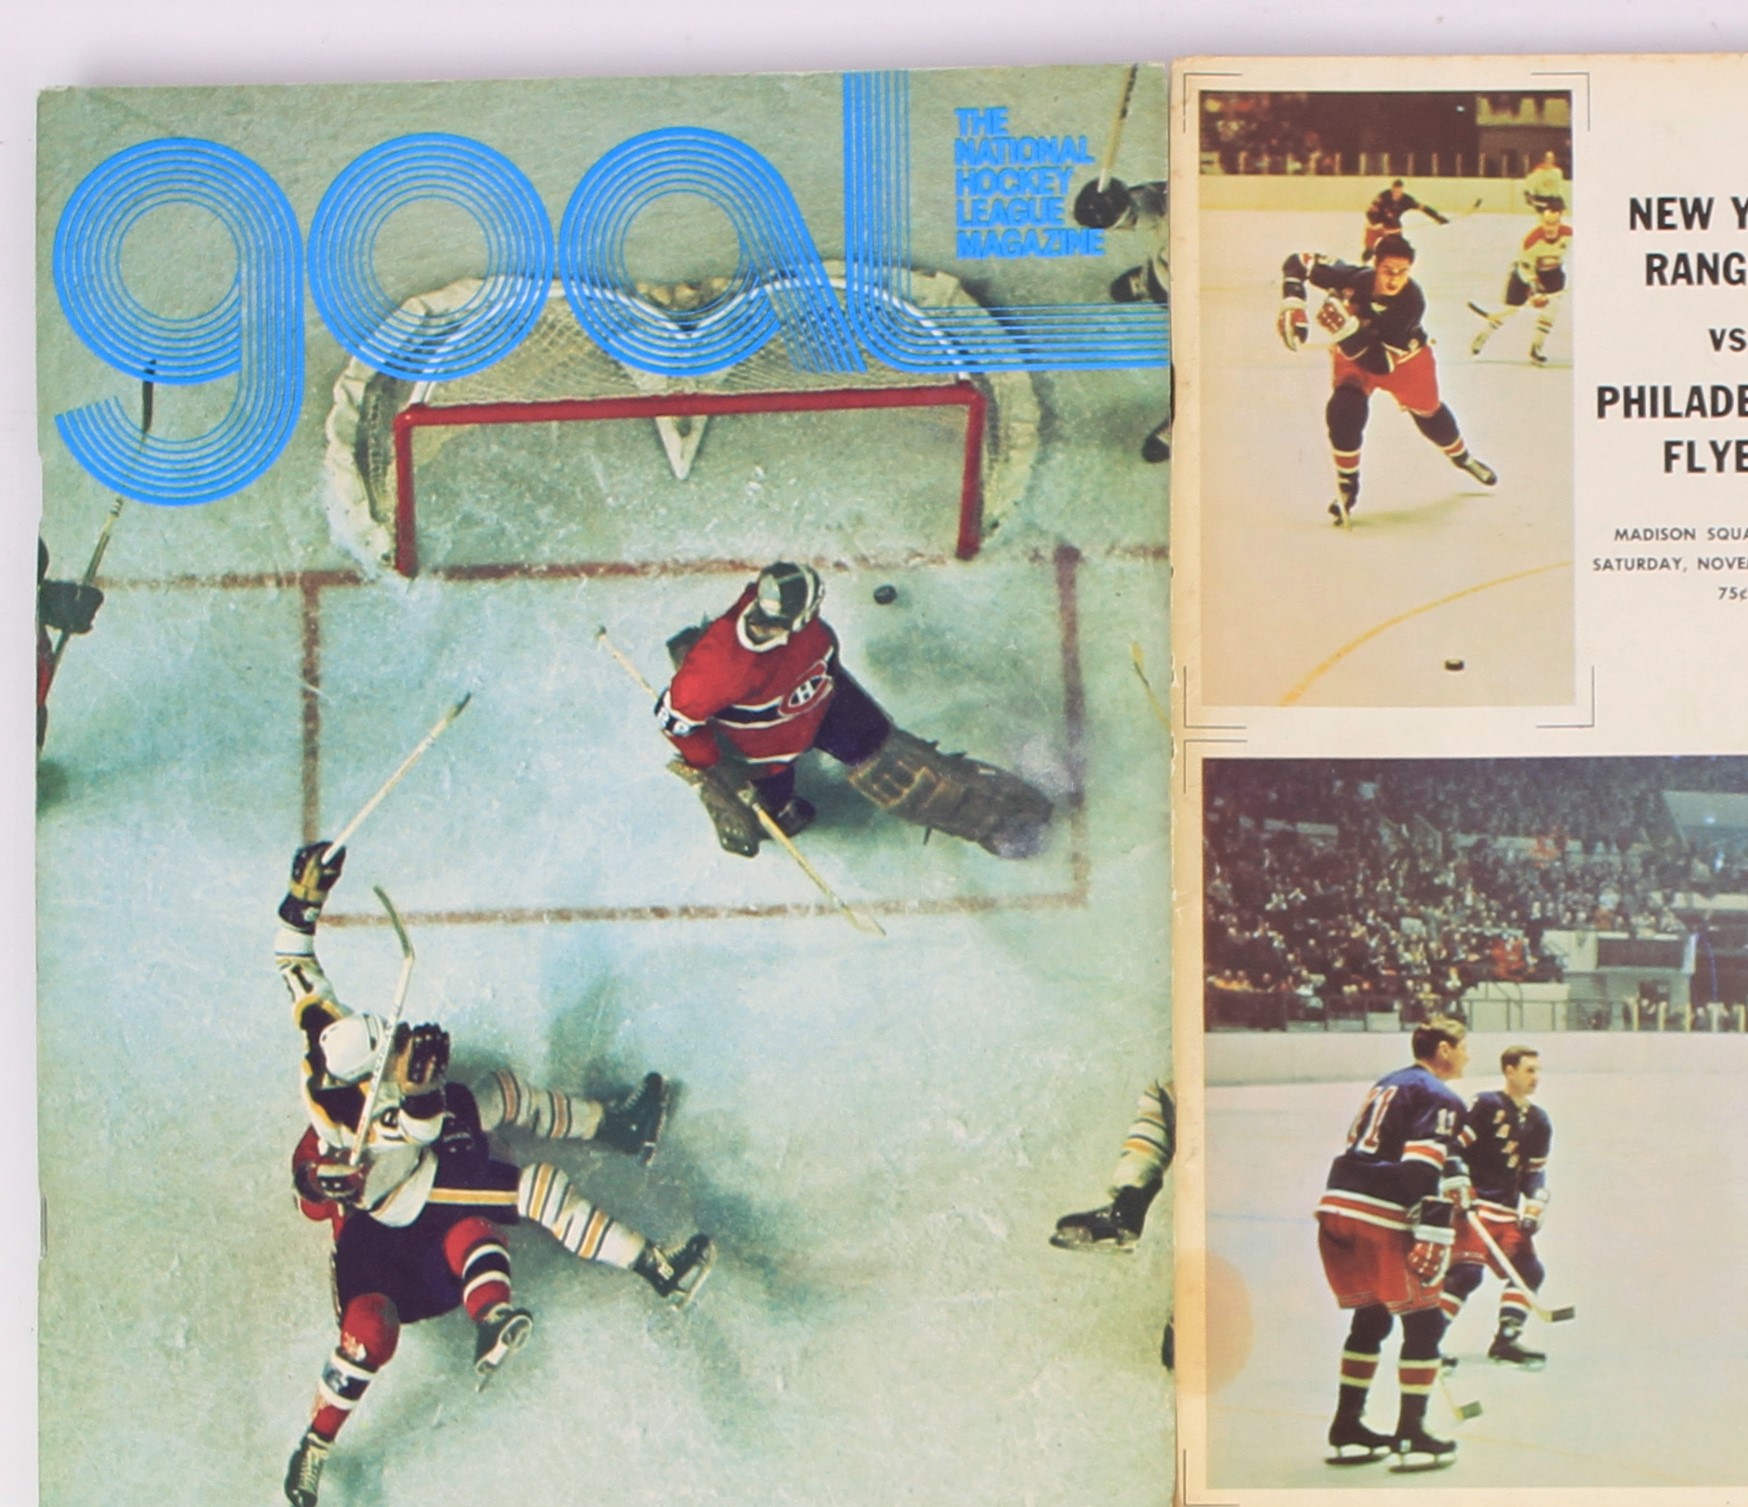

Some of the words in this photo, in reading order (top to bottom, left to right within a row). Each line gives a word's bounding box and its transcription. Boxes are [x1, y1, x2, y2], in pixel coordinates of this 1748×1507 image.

[955, 107, 1009, 136] THE
[955, 136, 1094, 166] NATIONAL
[956, 168, 1074, 196] HOCKEY
[957, 198, 1065, 227] LEAGUE
[1629, 196, 1714, 231] NEW
[957, 229, 1105, 259] MAGAZINE
[54, 74, 1168, 507] goal
[1614, 527, 1696, 542] MADISON
[1592, 556, 1688, 573] SATURDAY,
[1718, 586, 1748, 602] 75¢
